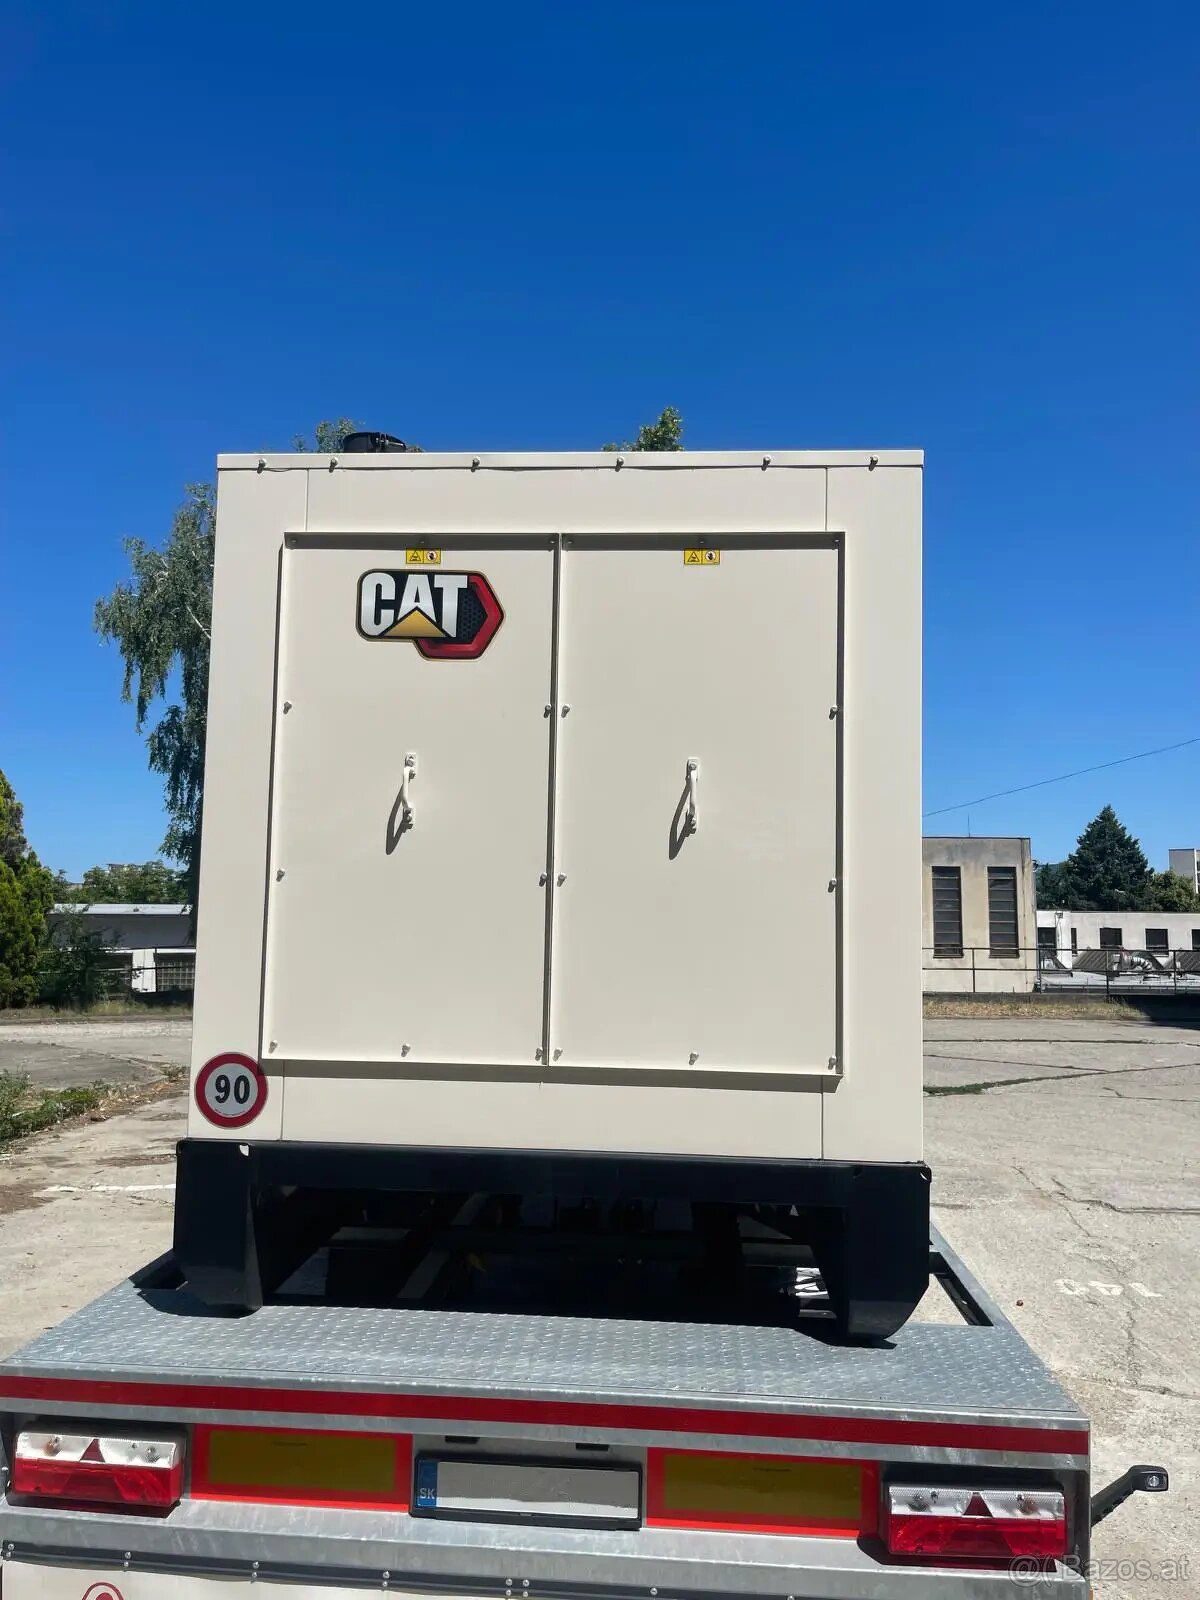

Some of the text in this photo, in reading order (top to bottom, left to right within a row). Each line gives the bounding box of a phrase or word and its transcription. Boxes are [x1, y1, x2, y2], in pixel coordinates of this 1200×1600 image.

[360, 572, 468, 638] CAT
[214, 1074, 251, 1105] 90
[419, 1487, 436, 1500] SK
